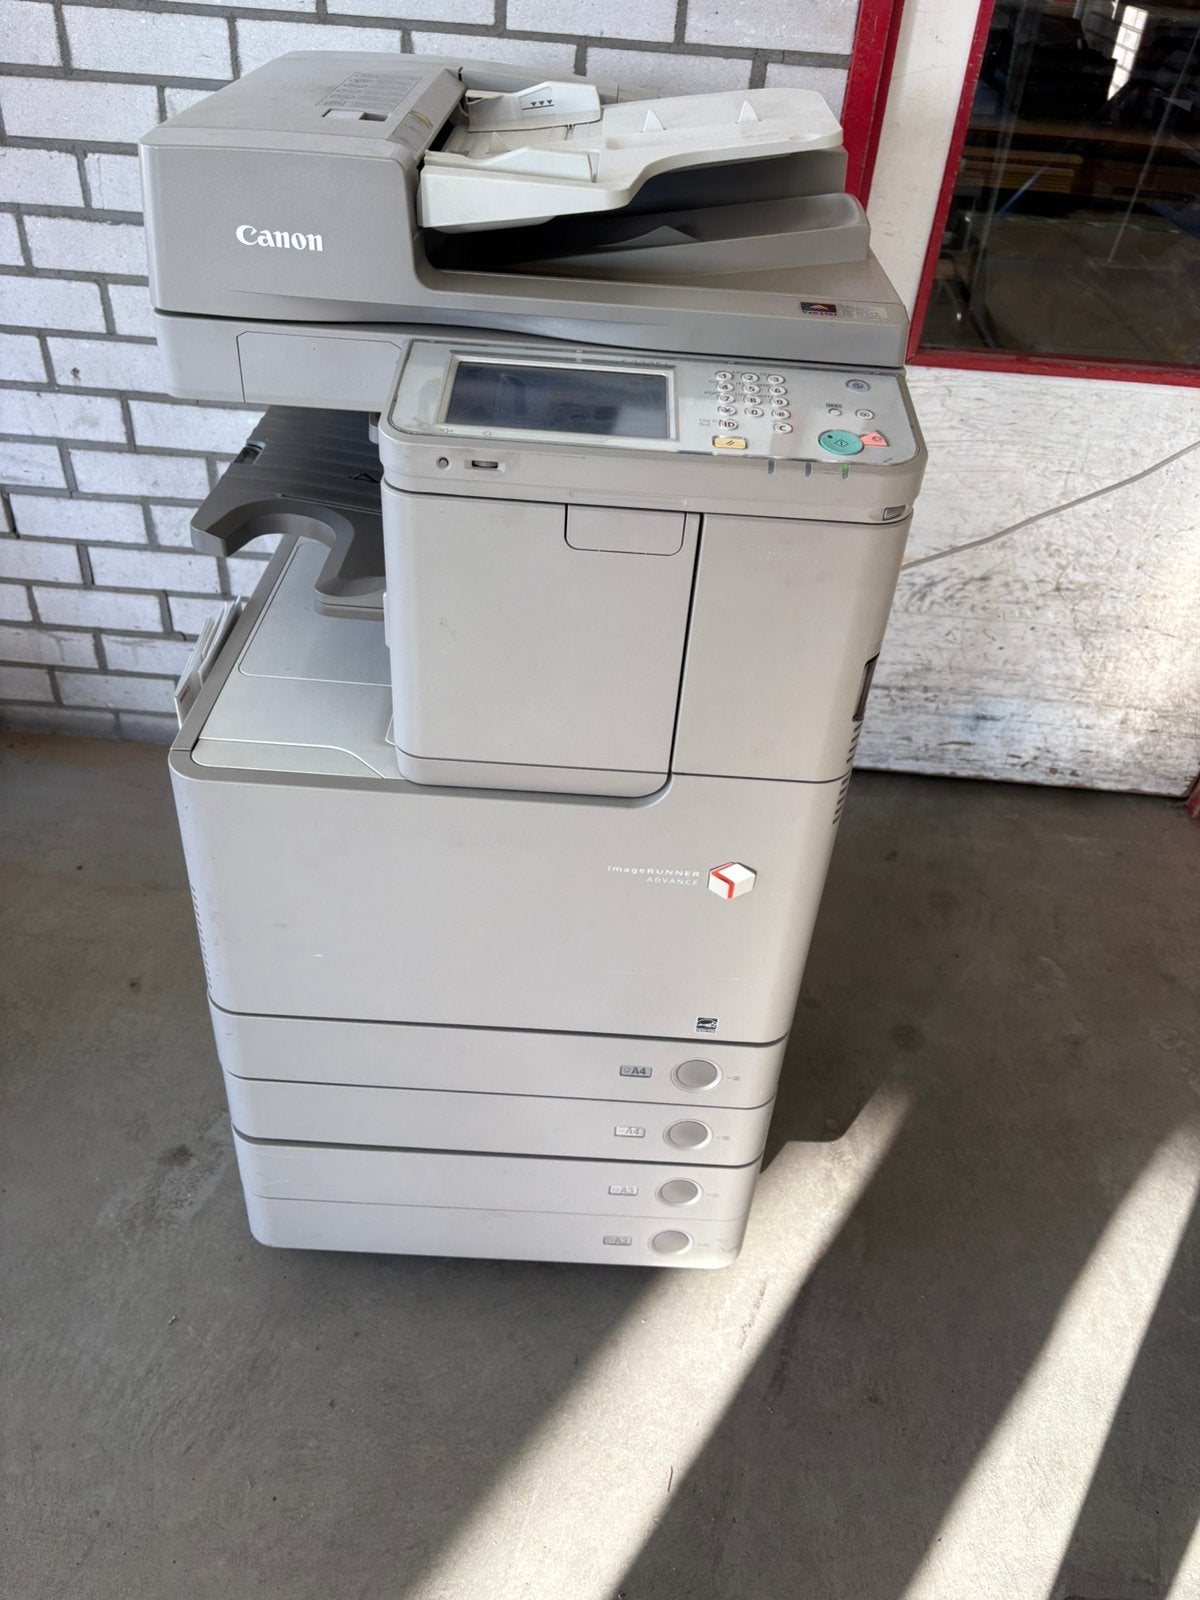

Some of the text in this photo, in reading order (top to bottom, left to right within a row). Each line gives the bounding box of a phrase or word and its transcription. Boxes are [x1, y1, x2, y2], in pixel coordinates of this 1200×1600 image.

[236, 224, 323, 252] Canon
[608, 865, 700, 877] imageRUNNER
[647, 877, 699, 886] ADVANCE
[631, 1066, 646, 1075] A4
[626, 1127, 640, 1136] A4
[621, 1187, 634, 1195] A3
